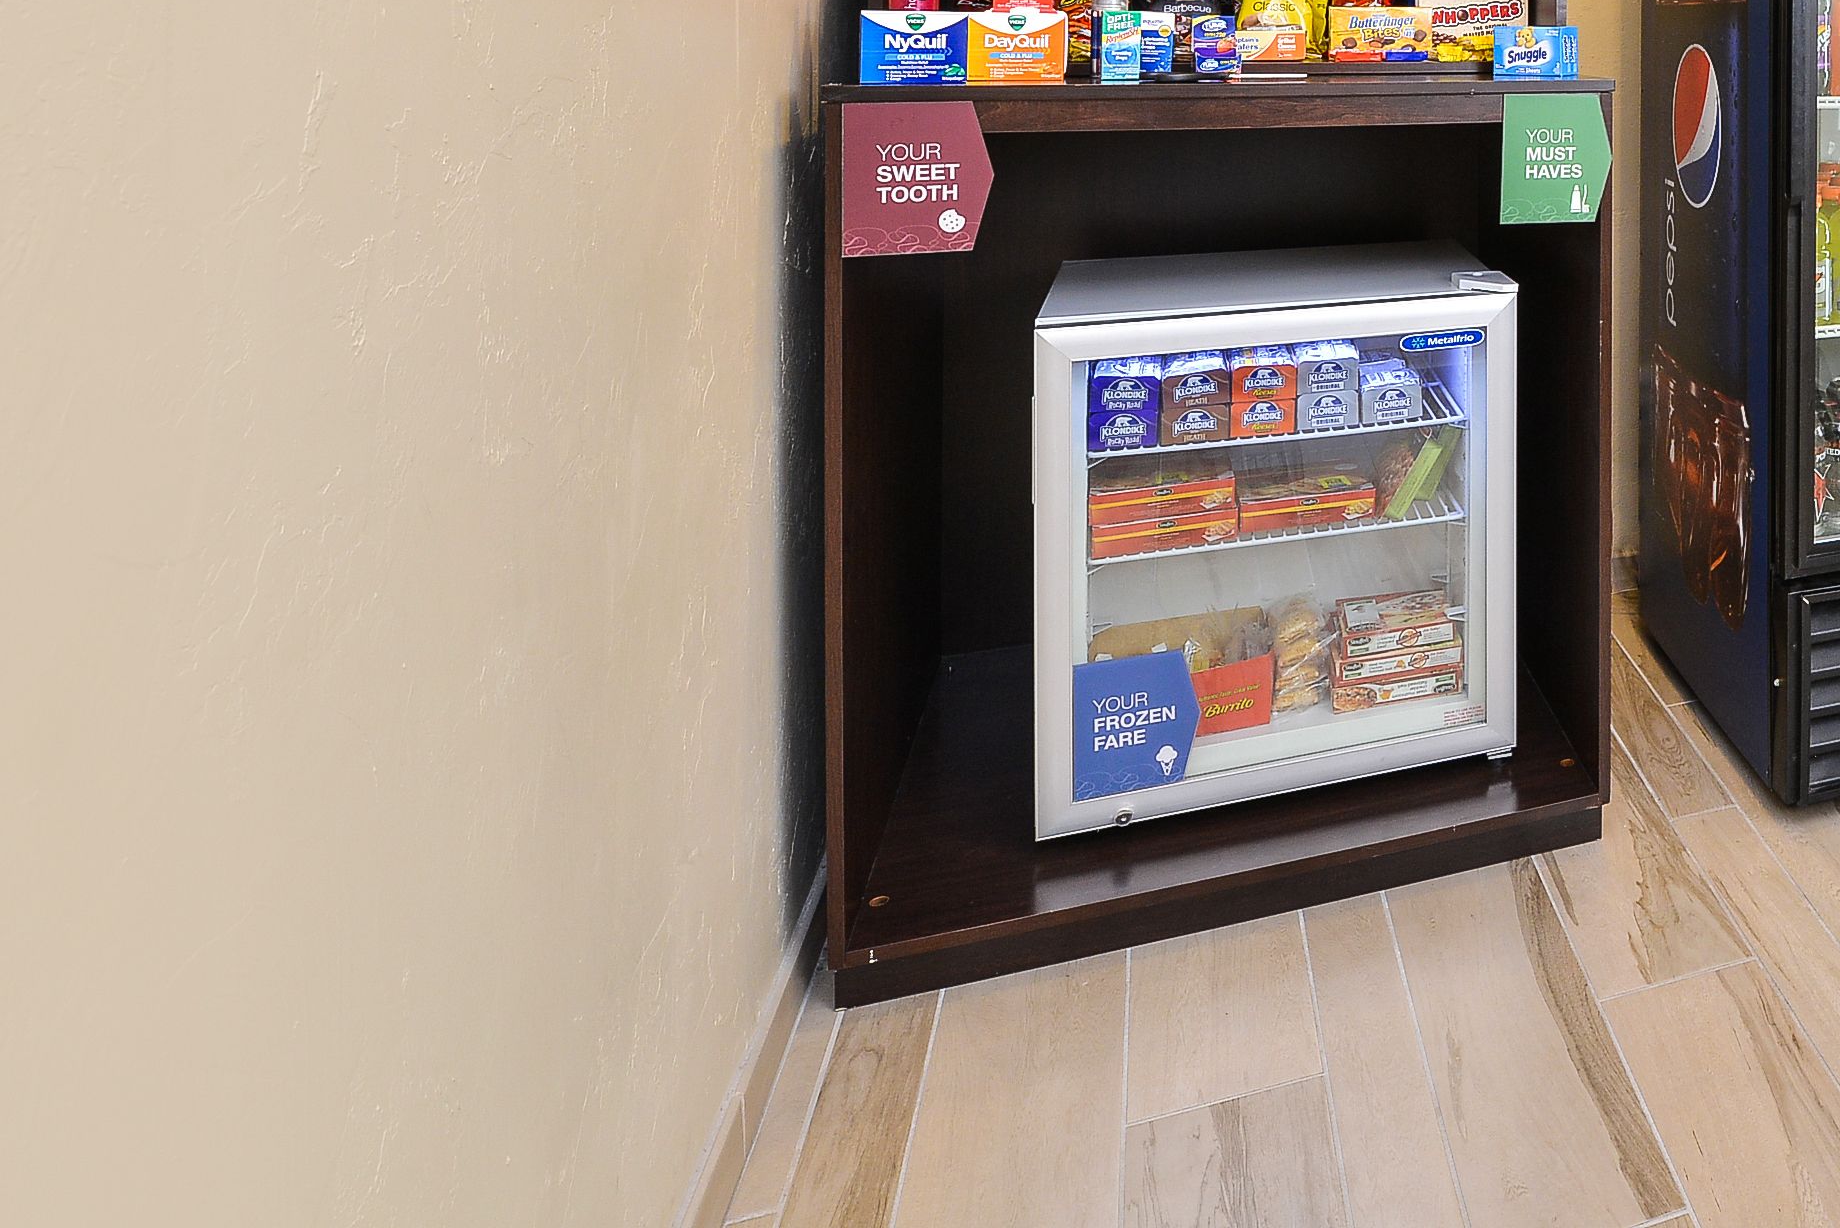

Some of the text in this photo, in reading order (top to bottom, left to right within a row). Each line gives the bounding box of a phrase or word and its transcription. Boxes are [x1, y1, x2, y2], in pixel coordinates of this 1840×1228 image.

[1163, 4, 1212, 14] Barbecue
[1253, 1, 1296, 12] Classic
[1107, 21, 1135, 31] FREE
[1349, 16, 1416, 30] Butterfinger
[884, 33, 948, 52] NyQuil
[984, 33, 1050, 52] DayQuil
[1362, 28, 1401, 42] Bites
[1507, 48, 1548, 64] Snuggle
[1526, 129, 1573, 143] YOUR
[875, 142, 941, 162] YOUR
[1526, 146, 1577, 161] MUST
[876, 163, 960, 183] SWEET
[1525, 164, 1583, 179] HAVES
[876, 184, 959, 204] TOOTH
[1665, 178, 1677, 327] pepsi
[1427, 334, 1474, 346] Metalfrio
[1243, 376, 1286, 394] KLONDIKE
[1308, 369, 1348, 386] KLONDIKE
[1103, 388, 1148, 405] KLONDIKE
[1174, 384, 1218, 402] KLONDIKE
[1308, 403, 1348, 420] KLONDIKE
[1373, 397, 1412, 414] KLONDIKE
[1172, 419, 1217, 437] KLONDIKE
[1242, 411, 1283, 429] KLONDIKE
[1100, 423, 1146, 441] KLONDIKE
[1092, 692, 1148, 715] YOUR
[1203, 697, 1254, 719] Burrito
[1094, 705, 1176, 733] FROZEN
[1094, 729, 1146, 751] FARE
